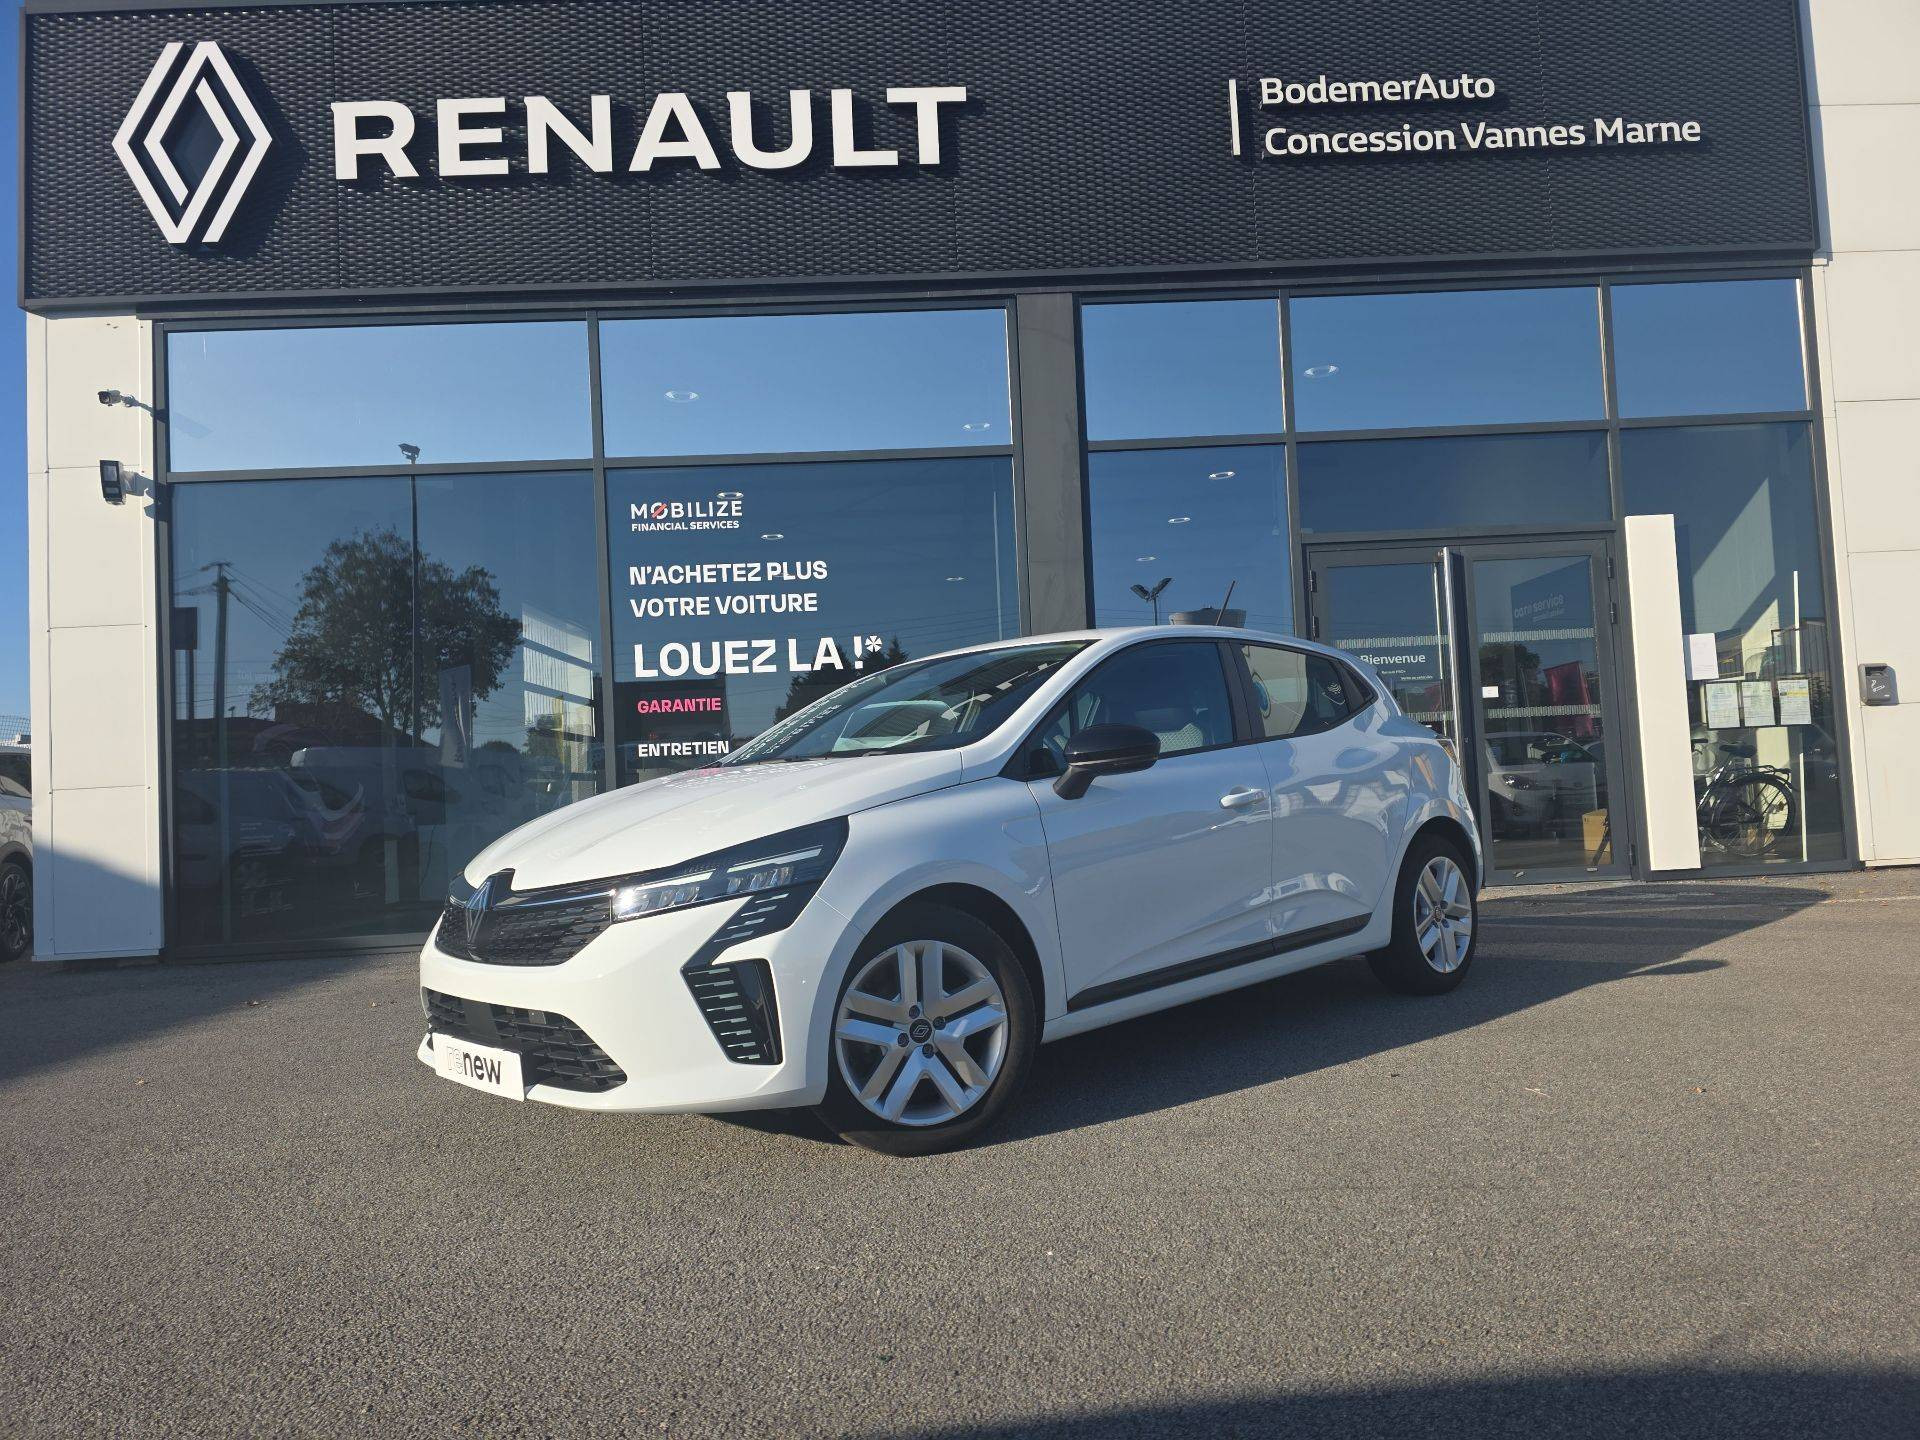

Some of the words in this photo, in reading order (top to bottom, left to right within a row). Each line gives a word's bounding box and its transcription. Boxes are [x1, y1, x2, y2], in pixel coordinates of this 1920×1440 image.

[1260, 73, 1495, 105] BodemerAuto
[331, 86, 967, 180] RENAULT
[1264, 124, 1456, 156] Concession
[1460, 121, 1585, 150] Vannes
[1594, 117, 1701, 145] Marne
[630, 500, 743, 520] MOBILIZE
[631, 522, 689, 532] FINANCIAL
[689, 520, 740, 530] SERVICES
[629, 562, 762, 586] N'ACHETEZ
[766, 560, 828, 581] PLUS
[630, 597, 710, 618] VOTRE
[714, 592, 818, 614] VOITURE
[634, 639, 777, 678] LOUEZ
[787, 637, 844, 672] LA
[1360, 653, 1426, 665] Bienvenue
[637, 697, 722, 714] GARANTIE
[637, 740, 730, 758] ENTRETIEN
